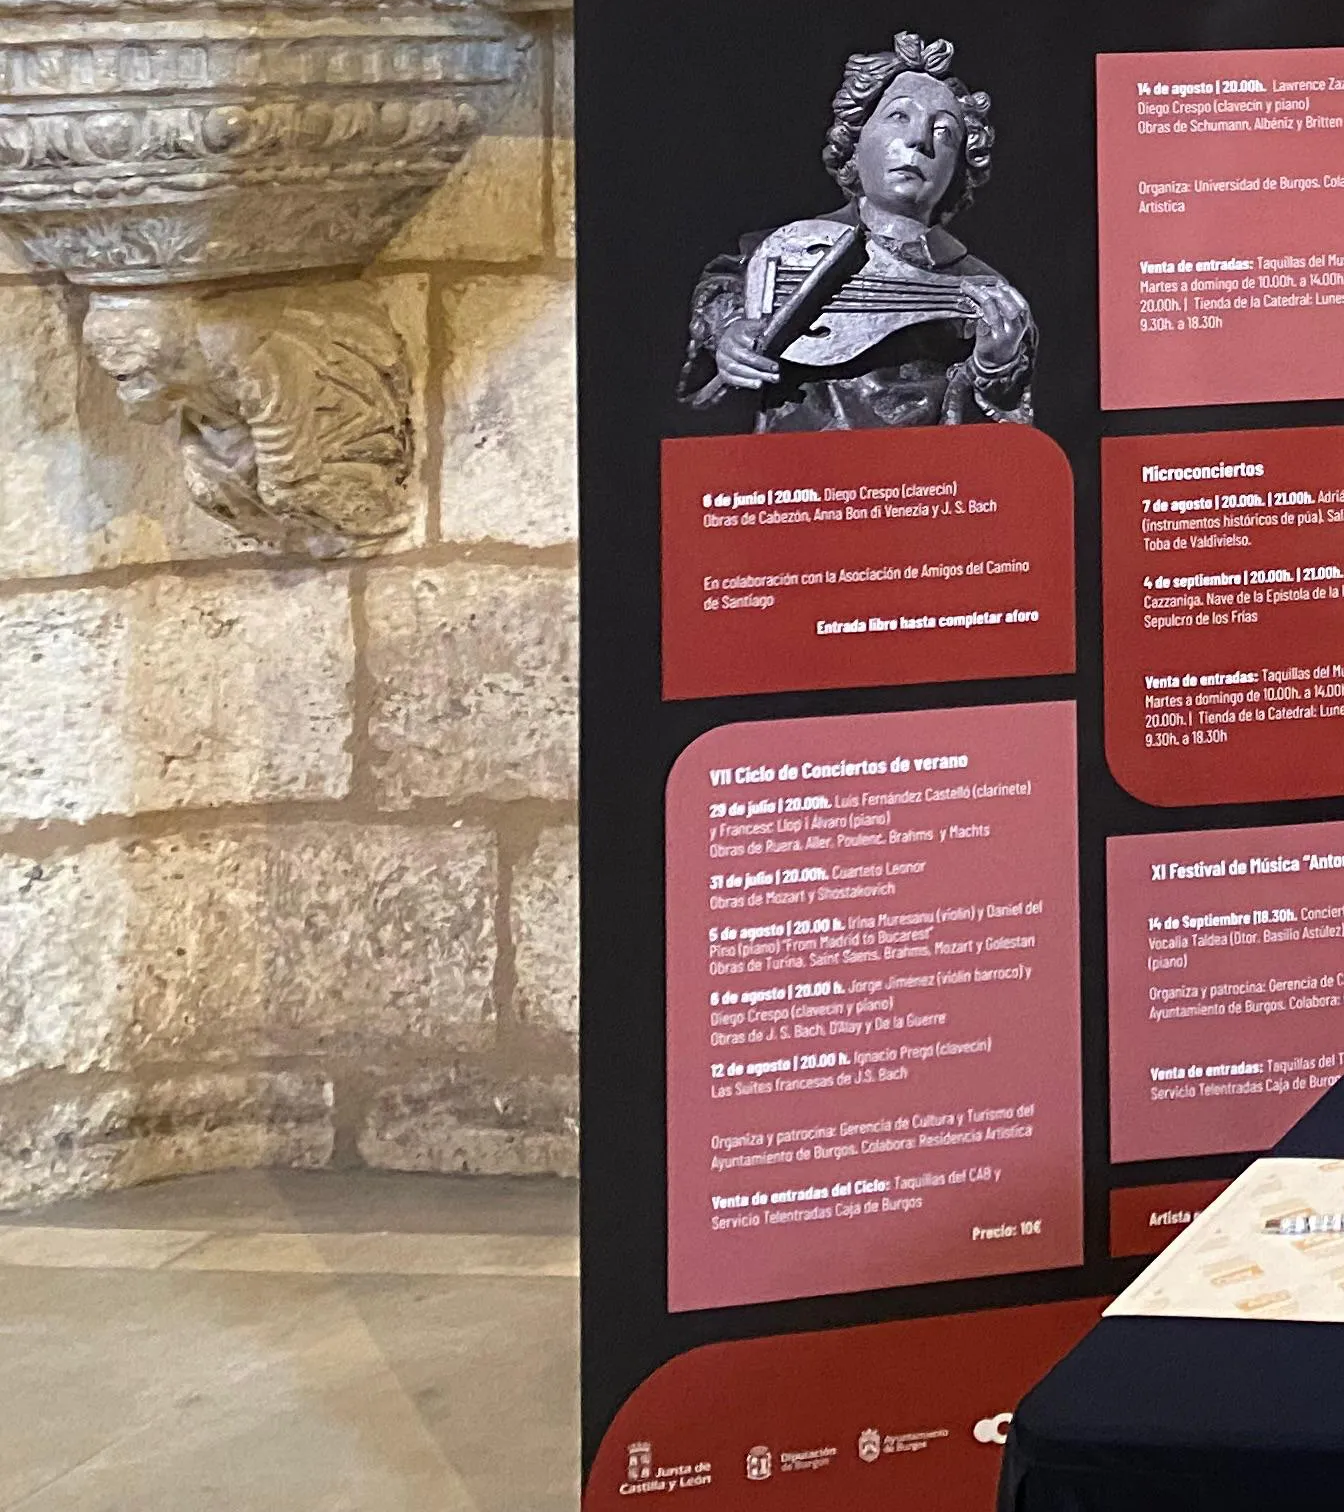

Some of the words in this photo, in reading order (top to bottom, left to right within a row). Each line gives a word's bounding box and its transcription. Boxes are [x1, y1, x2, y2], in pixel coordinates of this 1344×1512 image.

[1137, 83, 1151, 96] 14
[1153, 82, 1169, 95] de
[1171, 83, 1213, 97] agosto
[1222, 80, 1267, 93] 20.00h.
[1273, 81, 1326, 92] Lawrence
[1138, 102, 1170, 117] Diego
[1172, 96, 1212, 115] Crespo
[1266, 101, 1272, 114] y
[1275, 97, 1310, 112] piano)
[1138, 119, 1171, 134] Obras
[1173, 120, 1188, 133] de
[1254, 117, 1294, 130] Albéniz
[1296, 120, 1303, 131] y
[1306, 115, 1343, 128] Britten
[1139, 181, 1191, 196] Organiza:
[1194, 178, 1260, 192] Universidad
[1263, 177, 1277, 190] de
[1140, 261, 1175, 274] Venta
[1177, 260, 1193, 272] de
[1195, 258, 1254, 271] entradas:
[1257, 256, 1306, 271] Taquillas
[1308, 255, 1325, 267] del
[1143, 463, 1264, 481] Microconciertos
[714, 493, 731, 507] de
[732, 491, 766, 509] junio
[774, 489, 821, 504] 20.00h.
[824, 488, 857, 503] Diego
[860, 486, 900, 501] Crespo
[1142, 499, 1151, 513] 7
[1152, 499, 1168, 512] de
[1170, 498, 1213, 513] agosto
[1221, 494, 1266, 508] 20.00h.
[1274, 491, 1315, 505] 21.00h.
[703, 514, 738, 527] Obras
[740, 512, 756, 525] de
[813, 508, 843, 520] Anna
[845, 506, 868, 520] Bon
[870, 505, 881, 519] di
[932, 505, 939, 518] y
[941, 501, 952, 515] J.
[955, 500, 966, 514] S.
[969, 499, 997, 513] Bach
[1142, 518, 1221, 532] (instrumentos
[1223, 514, 1278, 527] históricos
[1280, 512, 1295, 524] de
[704, 576, 719, 591] En
[722, 574, 798, 589] colaboración
[801, 573, 823, 584] con
[825, 571, 836, 583] la
[838, 567, 901, 582] Asociación
[904, 566, 919, 579] de
[921, 564, 963, 579] Amigos
[966, 562, 984, 575] del
[986, 559, 1029, 574] Camino
[817, 620, 866, 634] Entrada
[869, 618, 898, 631] libre
[900, 616, 936, 629] hasta
[938, 612, 1003, 628] completar
[1005, 609, 1039, 623] aforo
[709, 769, 732, 786] VII
[735, 766, 775, 783] Ciclo
[778, 764, 798, 780] de
[802, 761, 887, 778] Conciertos
[890, 756, 910, 773] de
[913, 755, 968, 770] verano
[728, 802, 746, 816] de
[746, 799, 776, 818] julio
[785, 796, 832, 811] 20.00h.
[835, 796, 859, 808] Luis
[862, 791, 922, 805] Fernández
[972, 781, 1031, 798] (clarinete)
[1152, 864, 1166, 880] XI
[1169, 861, 1225, 879] Festival
[1229, 859, 1247, 875] de
[1250, 857, 1300, 873] Música
[1148, 917, 1162, 931] 14
[1164, 917, 1180, 929] de
[1182, 913, 1251, 930] Septiembre
[712, 1195, 749, 1209] Venta
[752, 1192, 768, 1205] de
[771, 1187, 829, 1203] entradas
[831, 1182, 852, 1197] del
[854, 1179, 890, 1194] Ciclo:
[895, 1174, 945, 1189] Taquillas
[948, 1170, 966, 1183] del
[996, 1170, 1000, 1181] y
[1149, 1210, 1191, 1226] Artista
[972, 1225, 1017, 1240] Precio:
[1020, 1220, 1042, 1235] 10€
[694, 1462, 711, 1473] de
[668, 1480, 677, 1492] y
